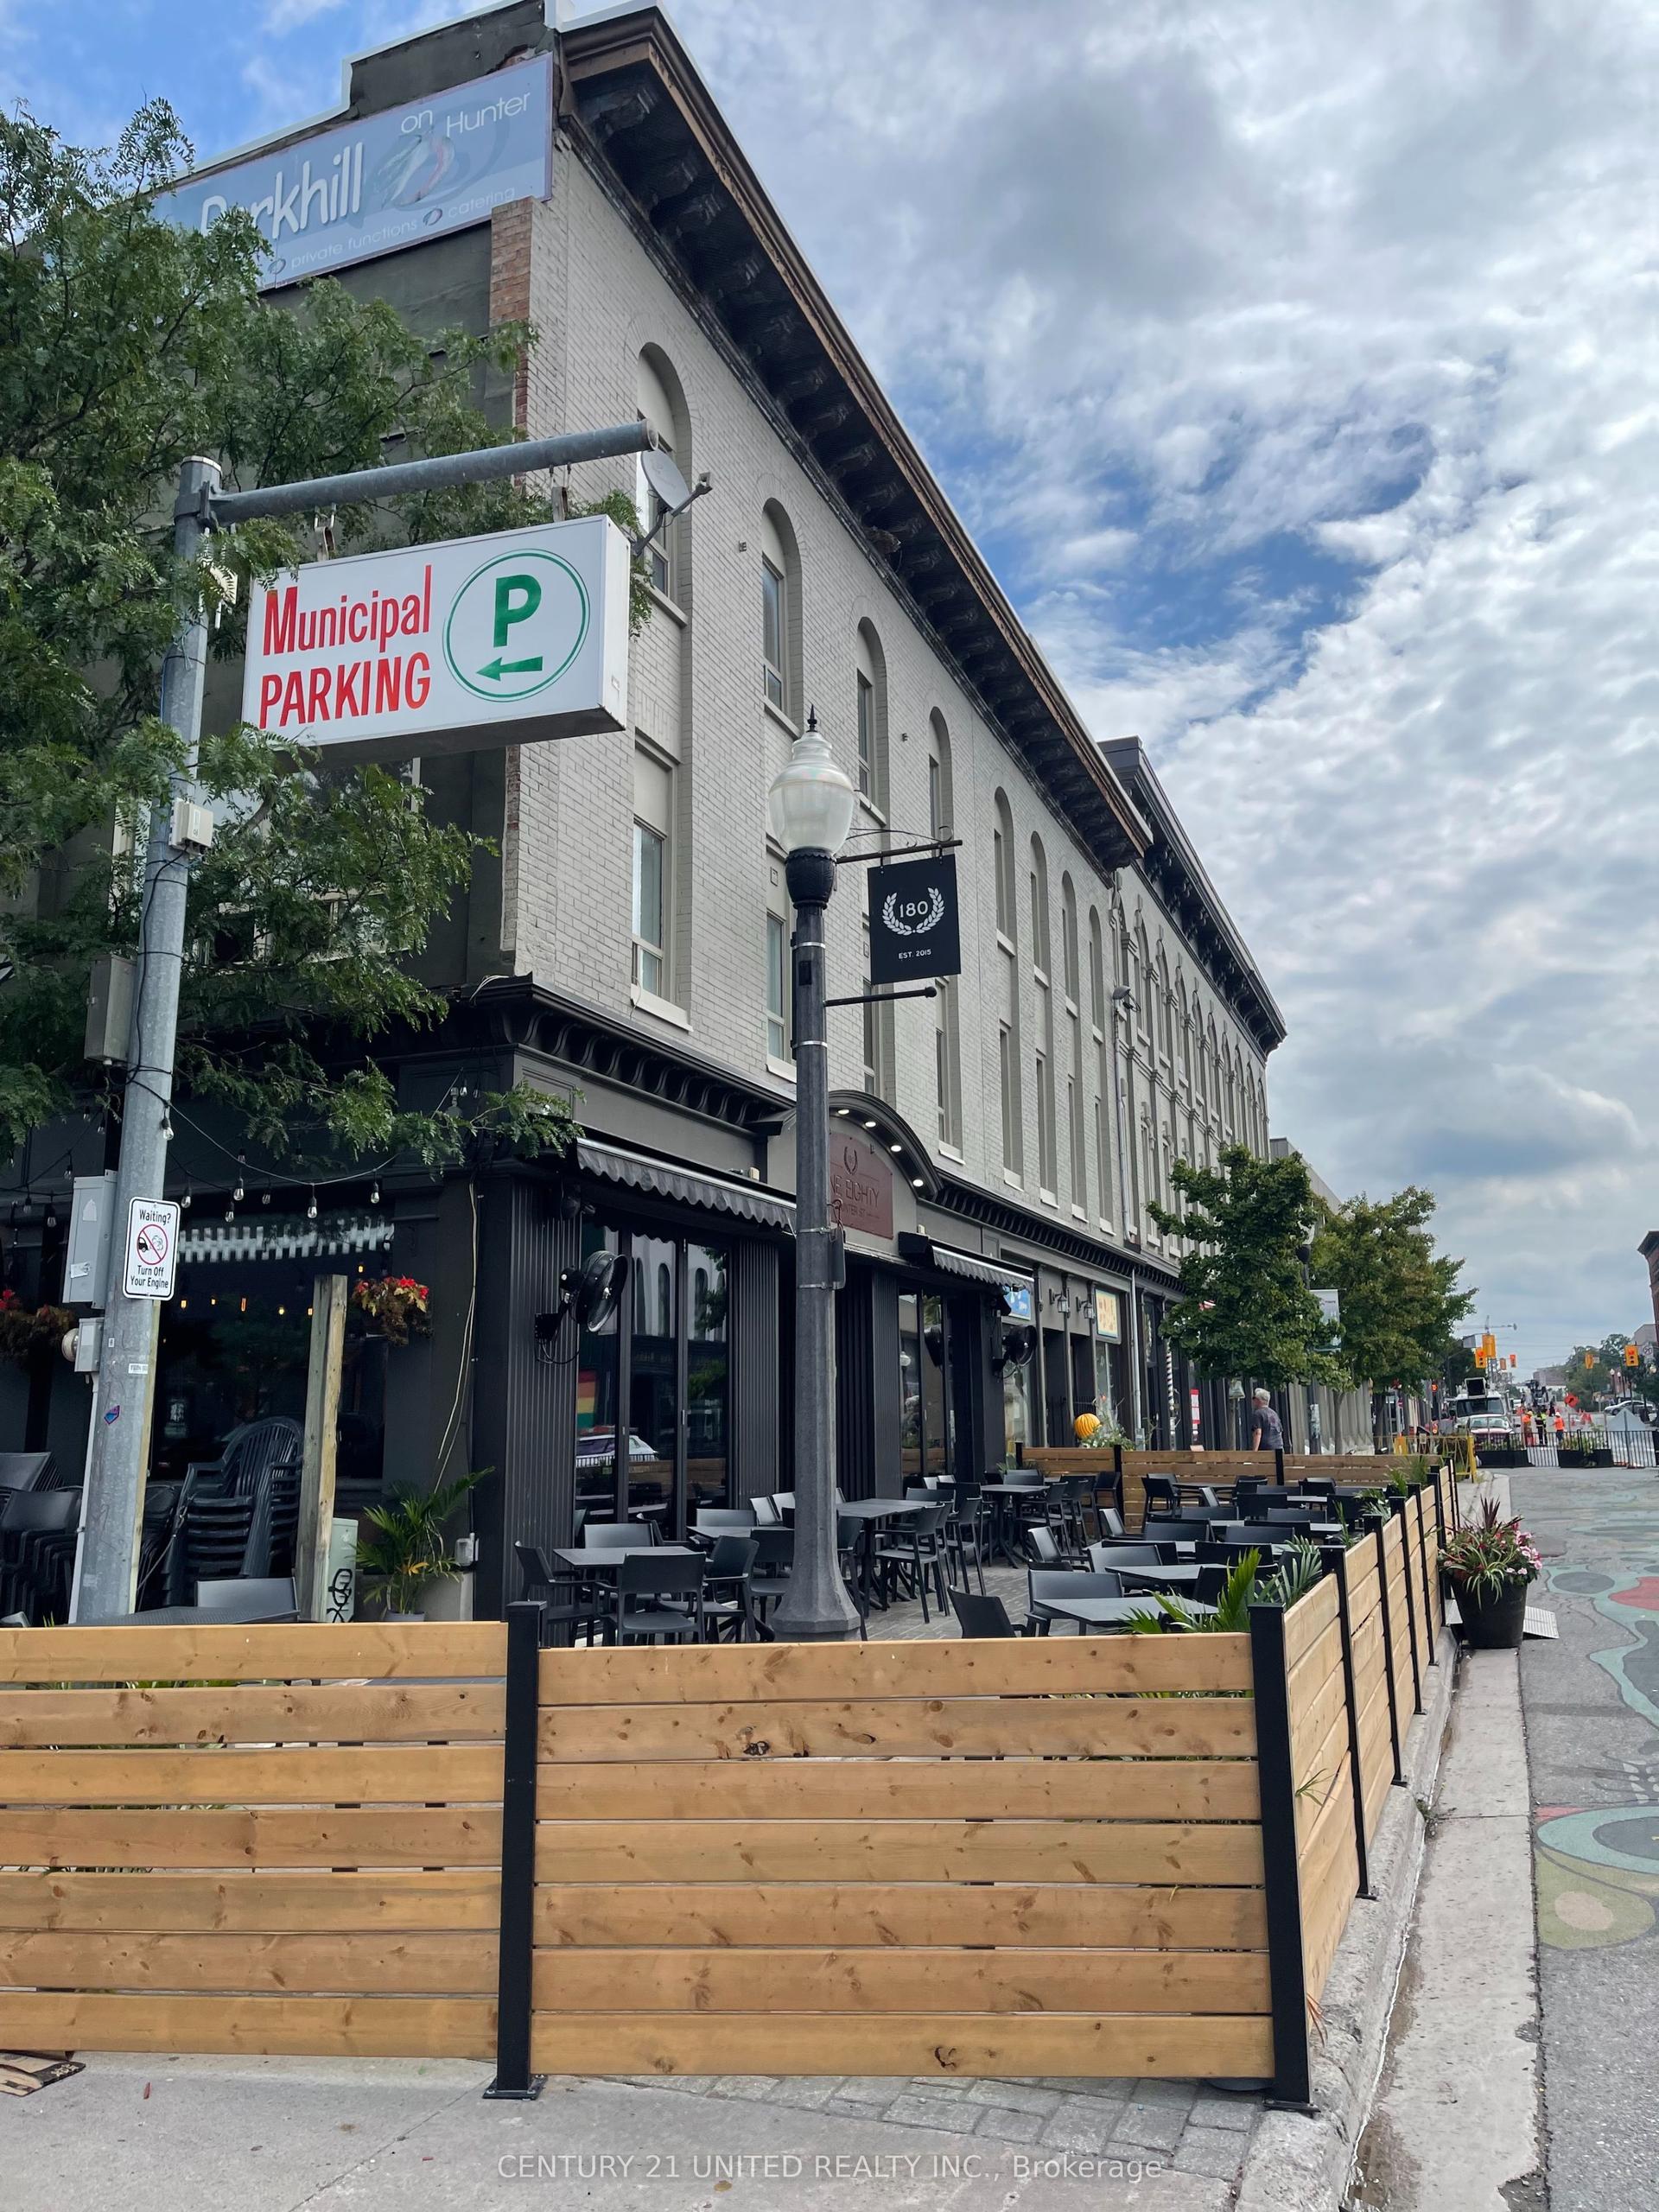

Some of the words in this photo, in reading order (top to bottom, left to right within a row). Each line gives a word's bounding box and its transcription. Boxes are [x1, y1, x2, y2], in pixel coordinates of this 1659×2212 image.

[401, 110, 434, 133] on
[446, 92, 531, 137] Hunter
[200, 142, 363, 239] Prkhill
[291, 243, 343, 270] private
[347, 218, 417, 250] functions
[448, 187, 516, 219] catering
[263, 564, 432, 657] Municipal
[493, 574, 542, 648] P
[259, 651, 431, 729] PARKING
[899, 900, 929, 918] 180
[846, 1179, 880, 1208] EIGHTY
[139, 1210, 171, 1225] Waiting?
[130, 1275, 146, 1287] Your
[147, 1277, 169, 1289] Engine
[137, 1265, 152, 1275] Turn
[154, 1267, 164, 1277] Off
